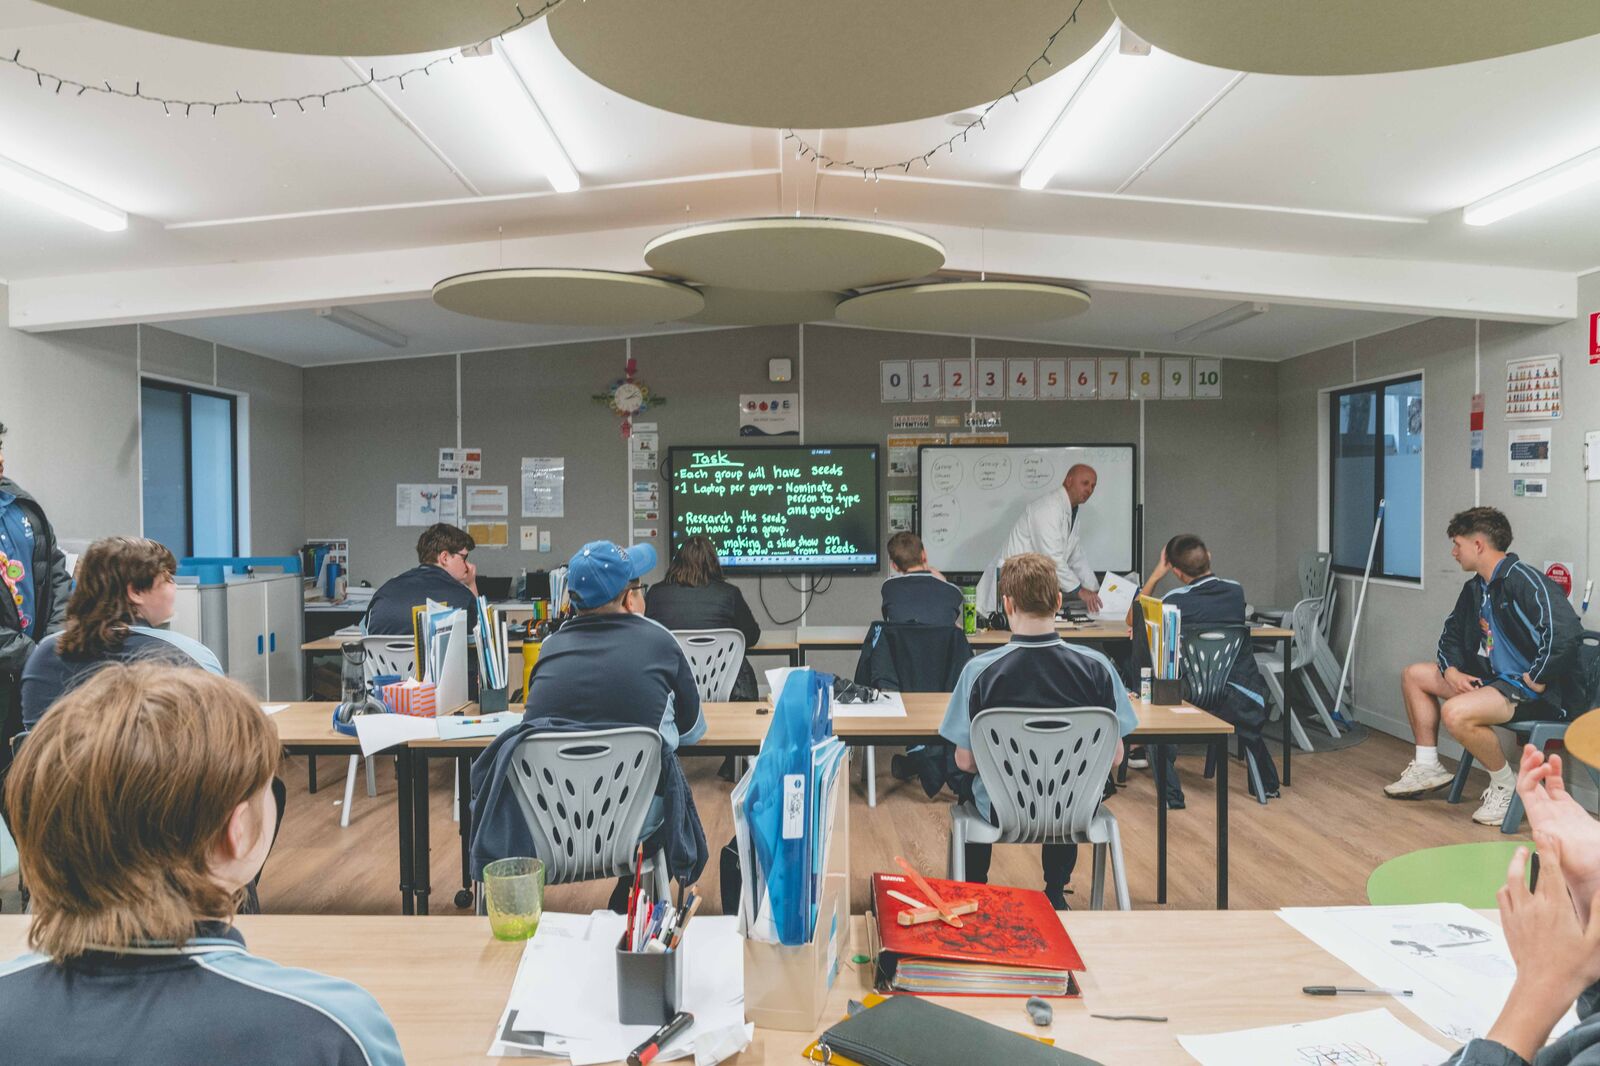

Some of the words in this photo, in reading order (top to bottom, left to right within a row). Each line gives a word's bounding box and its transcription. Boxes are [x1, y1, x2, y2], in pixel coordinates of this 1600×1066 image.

[889, 373, 901, 388] 0
[922, 373, 932, 388] 1
[952, 372, 963, 387] 2
[985, 372, 996, 386] 3
[1016, 372, 1028, 386] 4
[1047, 372, 1058, 386] 5
[1077, 371, 1088, 386] 6
[1108, 371, 1119, 386] 7
[1140, 371, 1150, 386] 8
[1171, 371, 1182, 386] 9
[1199, 371, 1219, 386] 10
[692, 450, 731, 464] Task
[680, 468, 708, 479] Each
[714, 470, 743, 483] group
[748, 465, 766, 479] will
[772, 464, 801, 479] have
[811, 463, 843, 476] seeds
[693, 483, 726, 497] Laptop
[730, 483, 745, 495] per
[749, 483, 774, 497] group
[785, 480, 834, 493] Nominate
[840, 484, 848, 492] a
[786, 494, 817, 506] person
[820, 492, 833, 504] to
[835, 492, 861, 508] type
[686, 510, 733, 524] Research
[740, 509, 757, 524] the
[761, 512, 787, 525] seeds
[786, 504, 808, 516] and
[685, 525, 702, 536] you
[705, 524, 731, 534] have
[736, 524, 747, 534] as
[750, 525, 758, 534] a
[723, 534, 761, 550] making
[766, 540, 774, 549] a
[776, 537, 796, 549] slide
[798, 534, 819, 547] show
[824, 535, 840, 546] on
[732, 547, 743, 556] to
[793, 546, 819, 555] from
